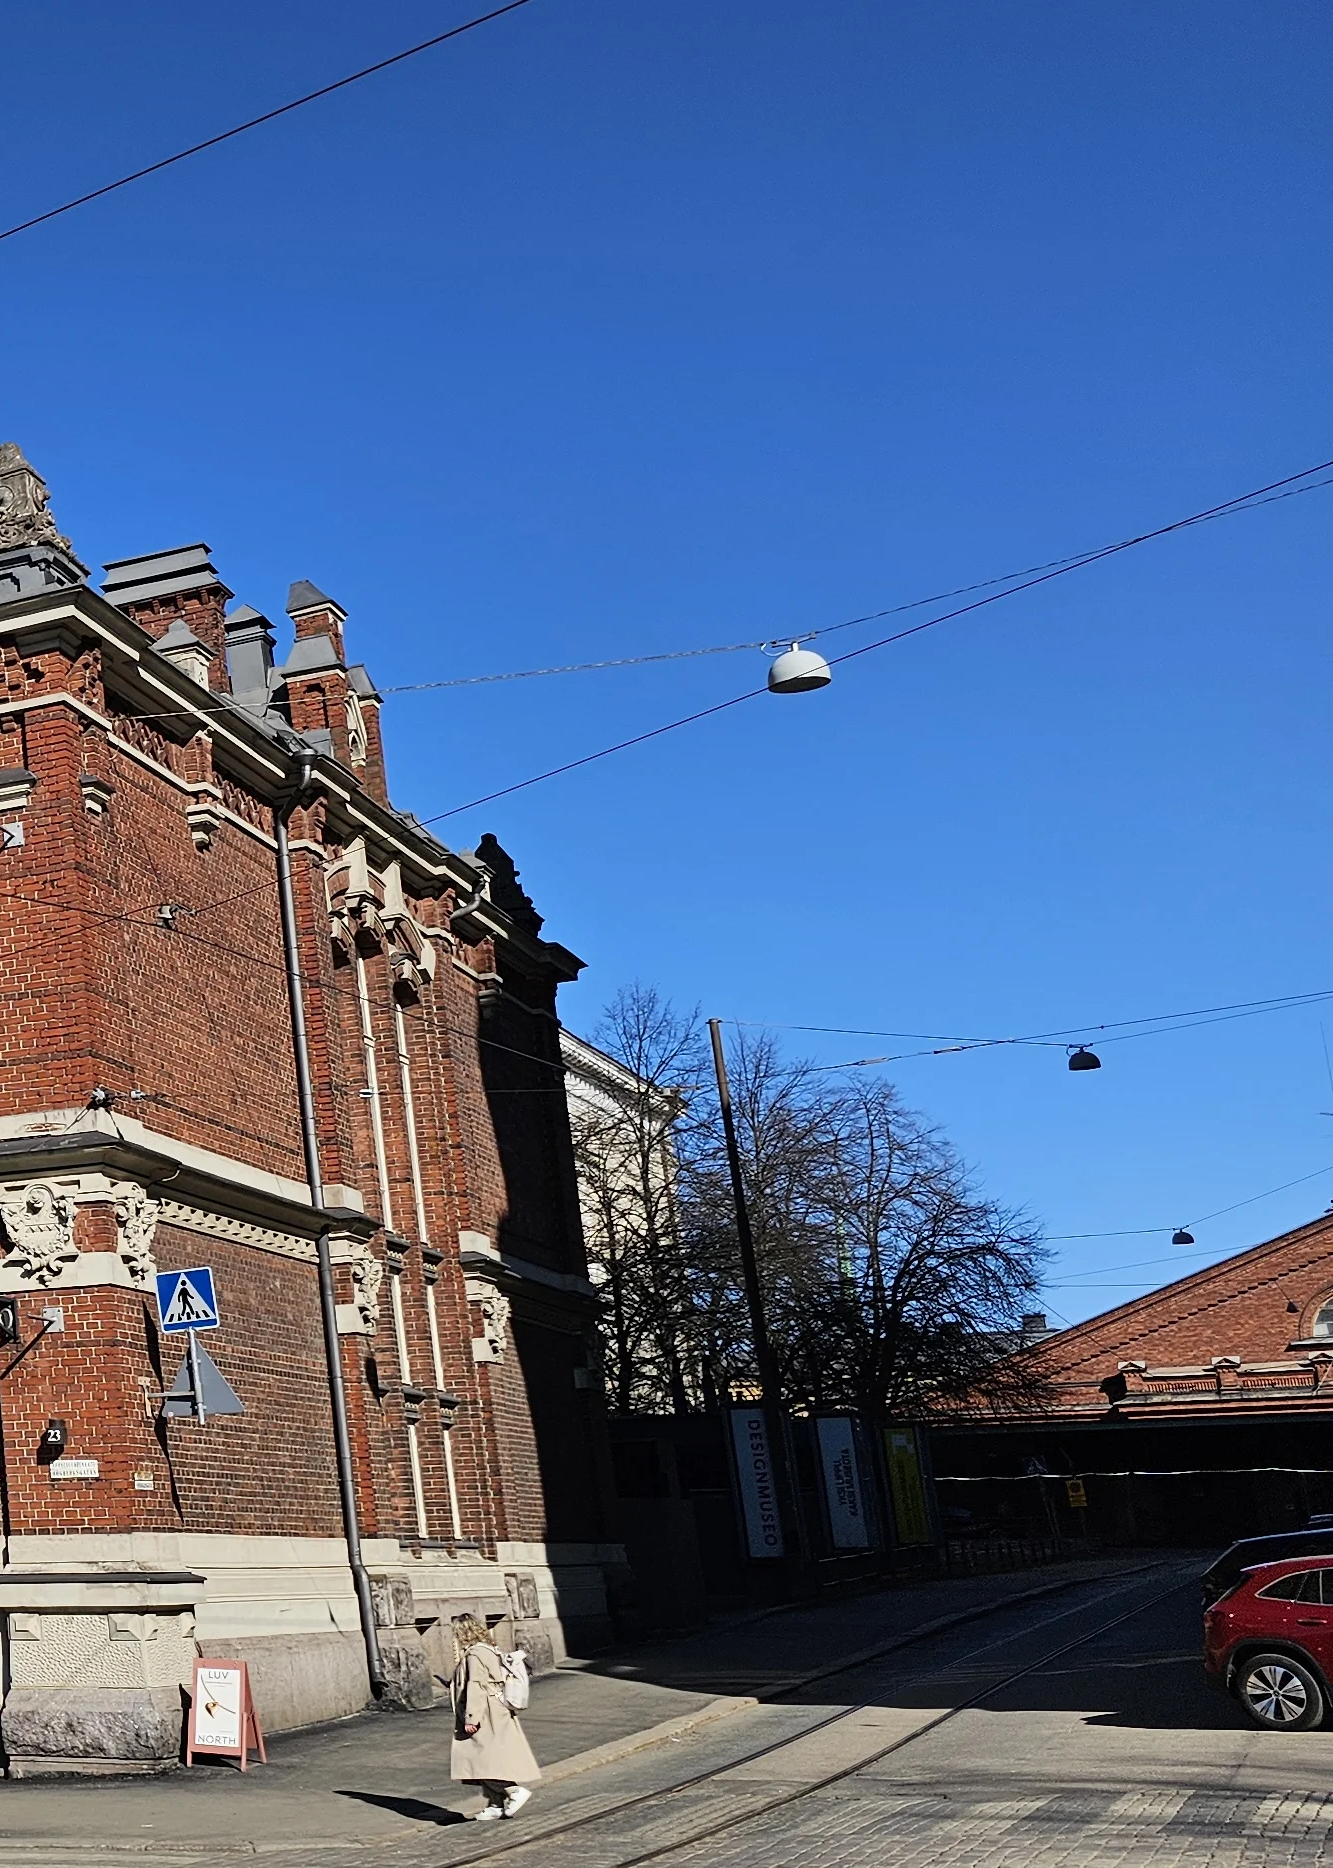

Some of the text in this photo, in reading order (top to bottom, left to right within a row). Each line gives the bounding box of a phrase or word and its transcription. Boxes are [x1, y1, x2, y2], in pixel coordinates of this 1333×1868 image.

[47, 1430, 61, 1442] 23
[747, 1419, 778, 1547] DESIGNMUSEO
[208, 1671, 229, 1679] LUV
[197, 1734, 236, 1745] NORTH
